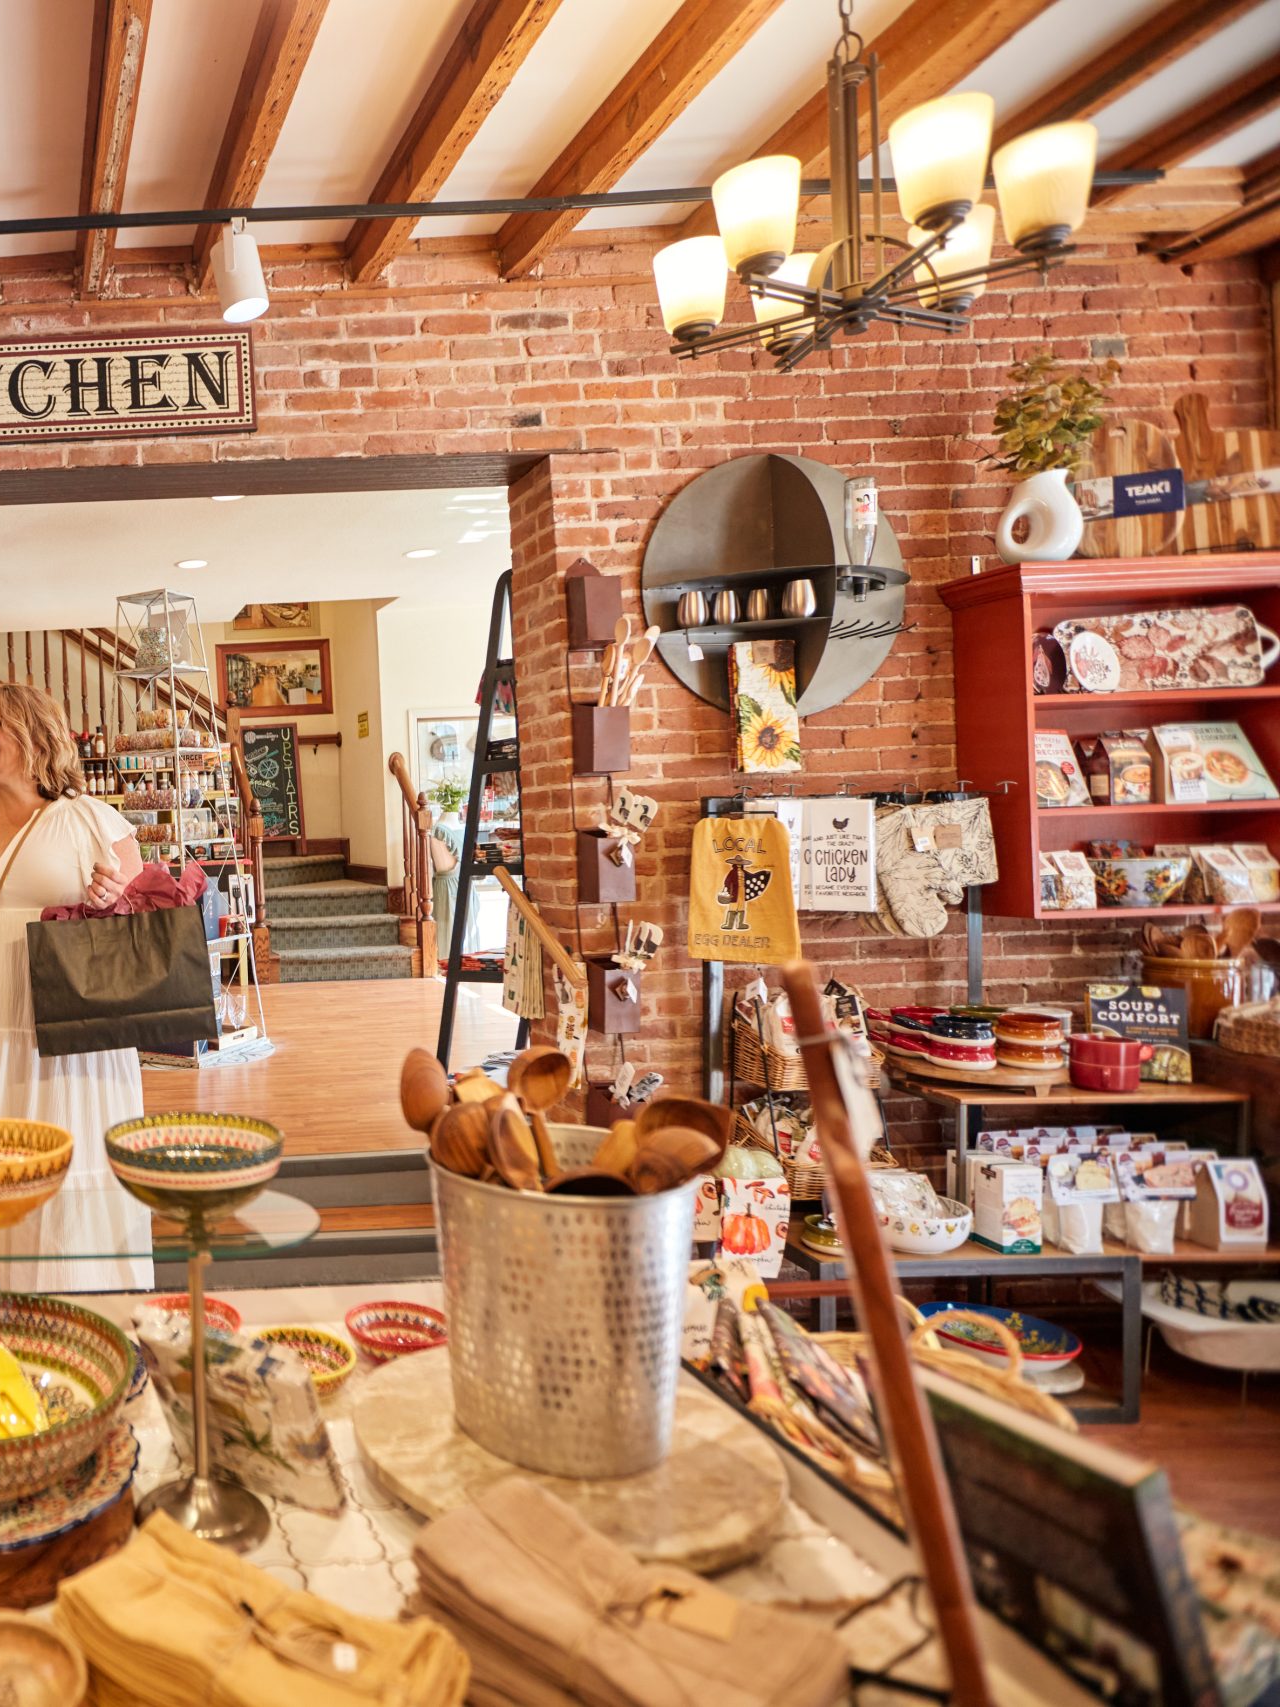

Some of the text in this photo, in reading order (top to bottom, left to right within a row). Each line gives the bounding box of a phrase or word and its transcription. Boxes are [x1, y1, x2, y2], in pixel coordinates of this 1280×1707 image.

[281, 727, 300, 836] UPSTAIRS
[712, 836, 767, 854] LOCAL
[694, 933, 771, 949] EGG DEALER
[1108, 1000, 1167, 1013] SOUP &
[1097, 1011, 1180, 1025] COMFORT
